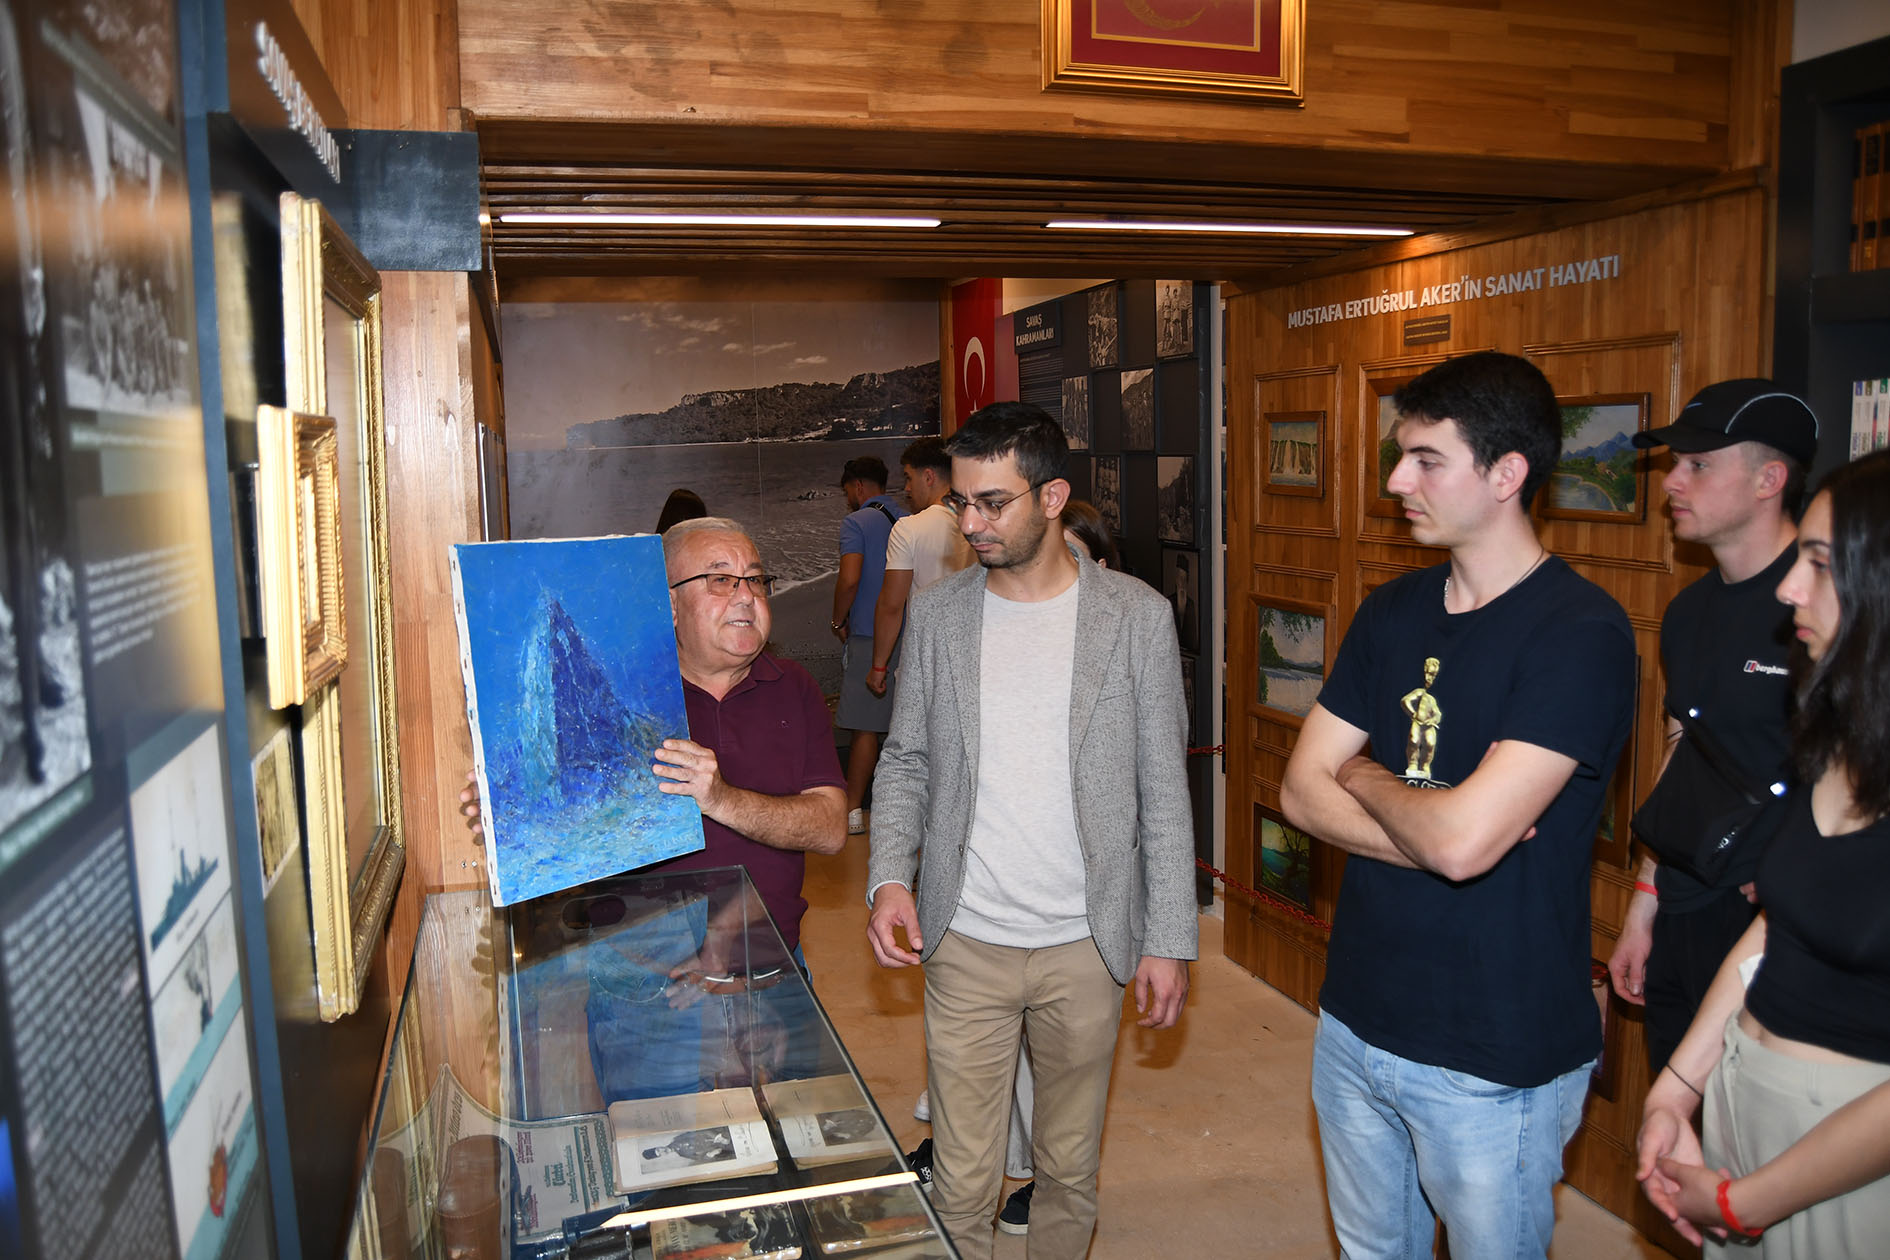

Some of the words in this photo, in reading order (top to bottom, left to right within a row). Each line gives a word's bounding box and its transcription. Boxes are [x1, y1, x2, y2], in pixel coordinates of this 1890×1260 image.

[1288, 304, 1344, 329] MUSTAFA
[1345, 289, 1418, 319] ERTUĞRUL
[1485, 268, 1545, 297] SANAT
[1550, 255, 1619, 287] HAYATI
